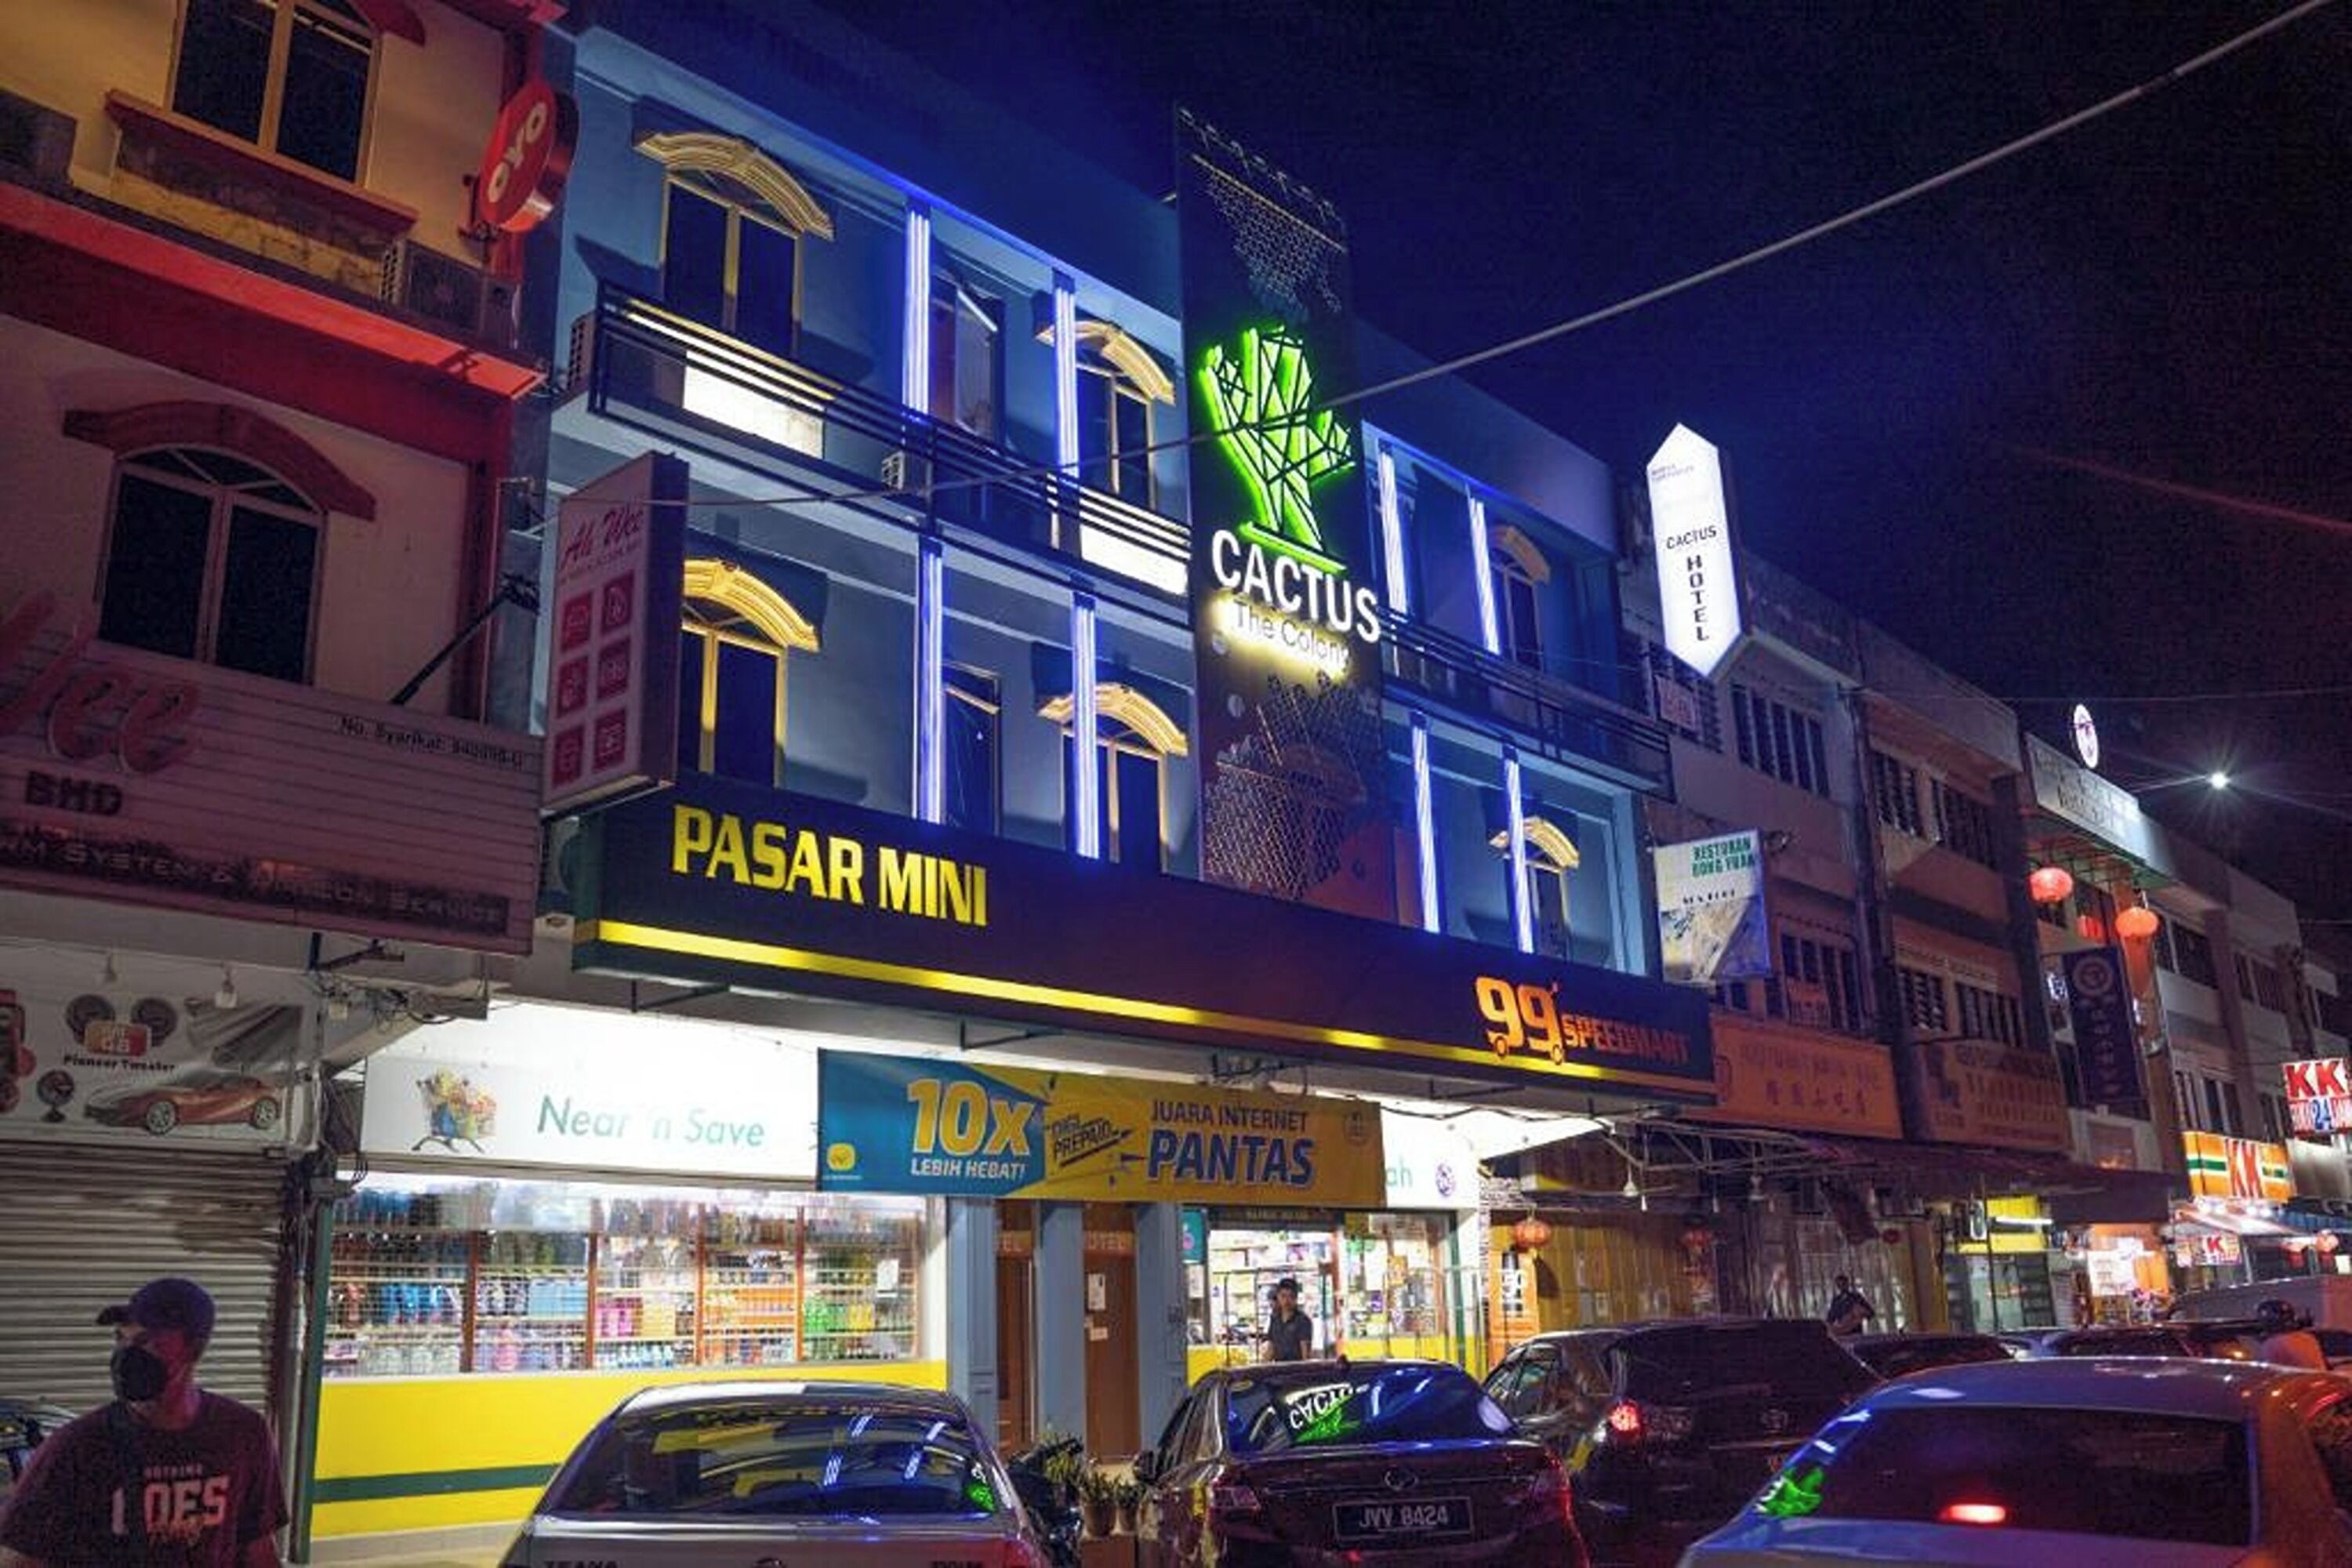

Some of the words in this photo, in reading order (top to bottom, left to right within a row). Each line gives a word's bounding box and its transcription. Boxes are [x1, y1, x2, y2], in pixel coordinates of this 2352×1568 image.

[488, 101, 549, 204] OYO
[1666, 524, 1717, 550] CACTUS
[1211, 529, 1381, 644] CACTUS
[1686, 554, 1710, 641] HOTEL
[1233, 597, 1275, 639] The
[24, 769, 123, 816] BHD
[672, 804, 864, 906] PASAR
[878, 845, 988, 927] MINI
[1475, 976, 1565, 1065] 99
[2285, 1060, 2347, 1098] KK
[536, 1093, 630, 1138] Near
[684, 1107, 765, 1147] Save
[1151, 1100, 1217, 1127] JUARA
[1218, 1105, 1308, 1134] INTERNET
[910, 1157, 962, 1177] LEBIH
[1147, 1127, 1315, 1187] PANTAS
[2225, 1139, 2265, 1199] KK
